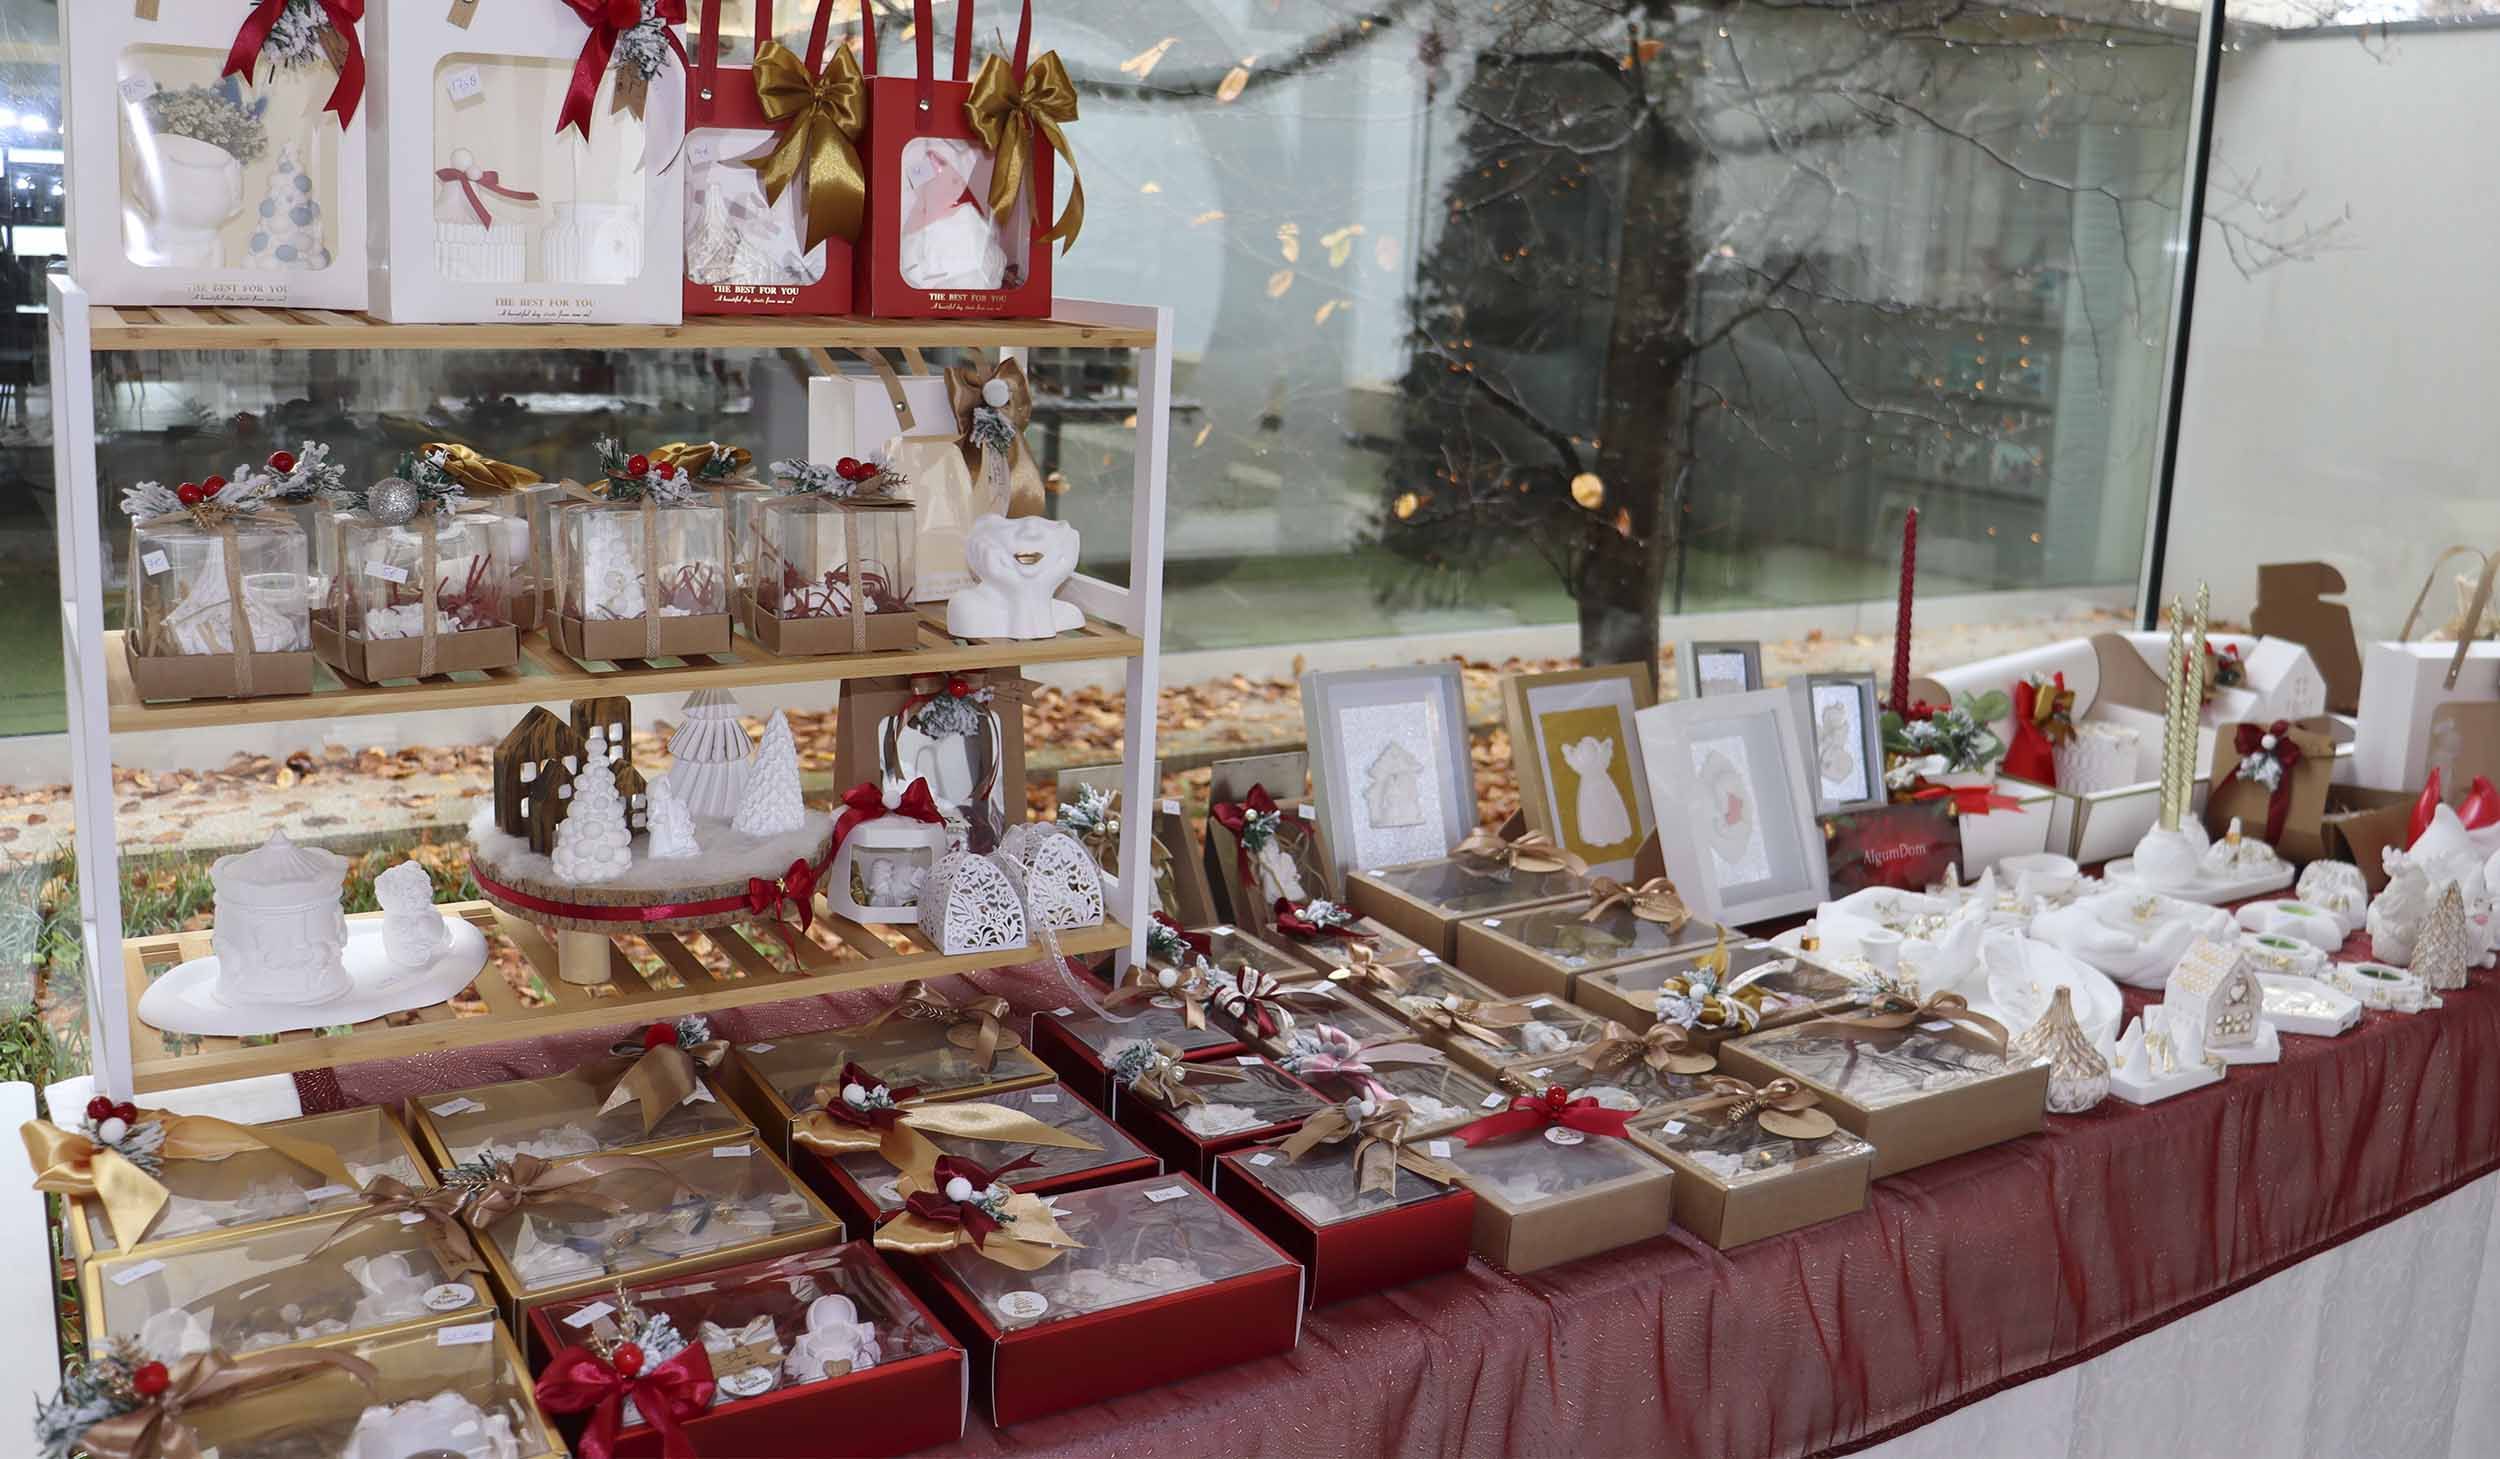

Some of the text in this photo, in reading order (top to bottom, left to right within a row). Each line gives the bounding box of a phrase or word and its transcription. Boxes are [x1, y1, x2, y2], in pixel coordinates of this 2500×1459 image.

[713, 285, 731, 293] THE
[735, 286, 755, 294] BEST
[781, 287, 799, 295] YOU
[495, 298, 593, 307] THE BEST FOR YOU
[929, 293, 1007, 303] THE BEST FOR YOU
[1863, 842, 1927, 867] AlgumDom
